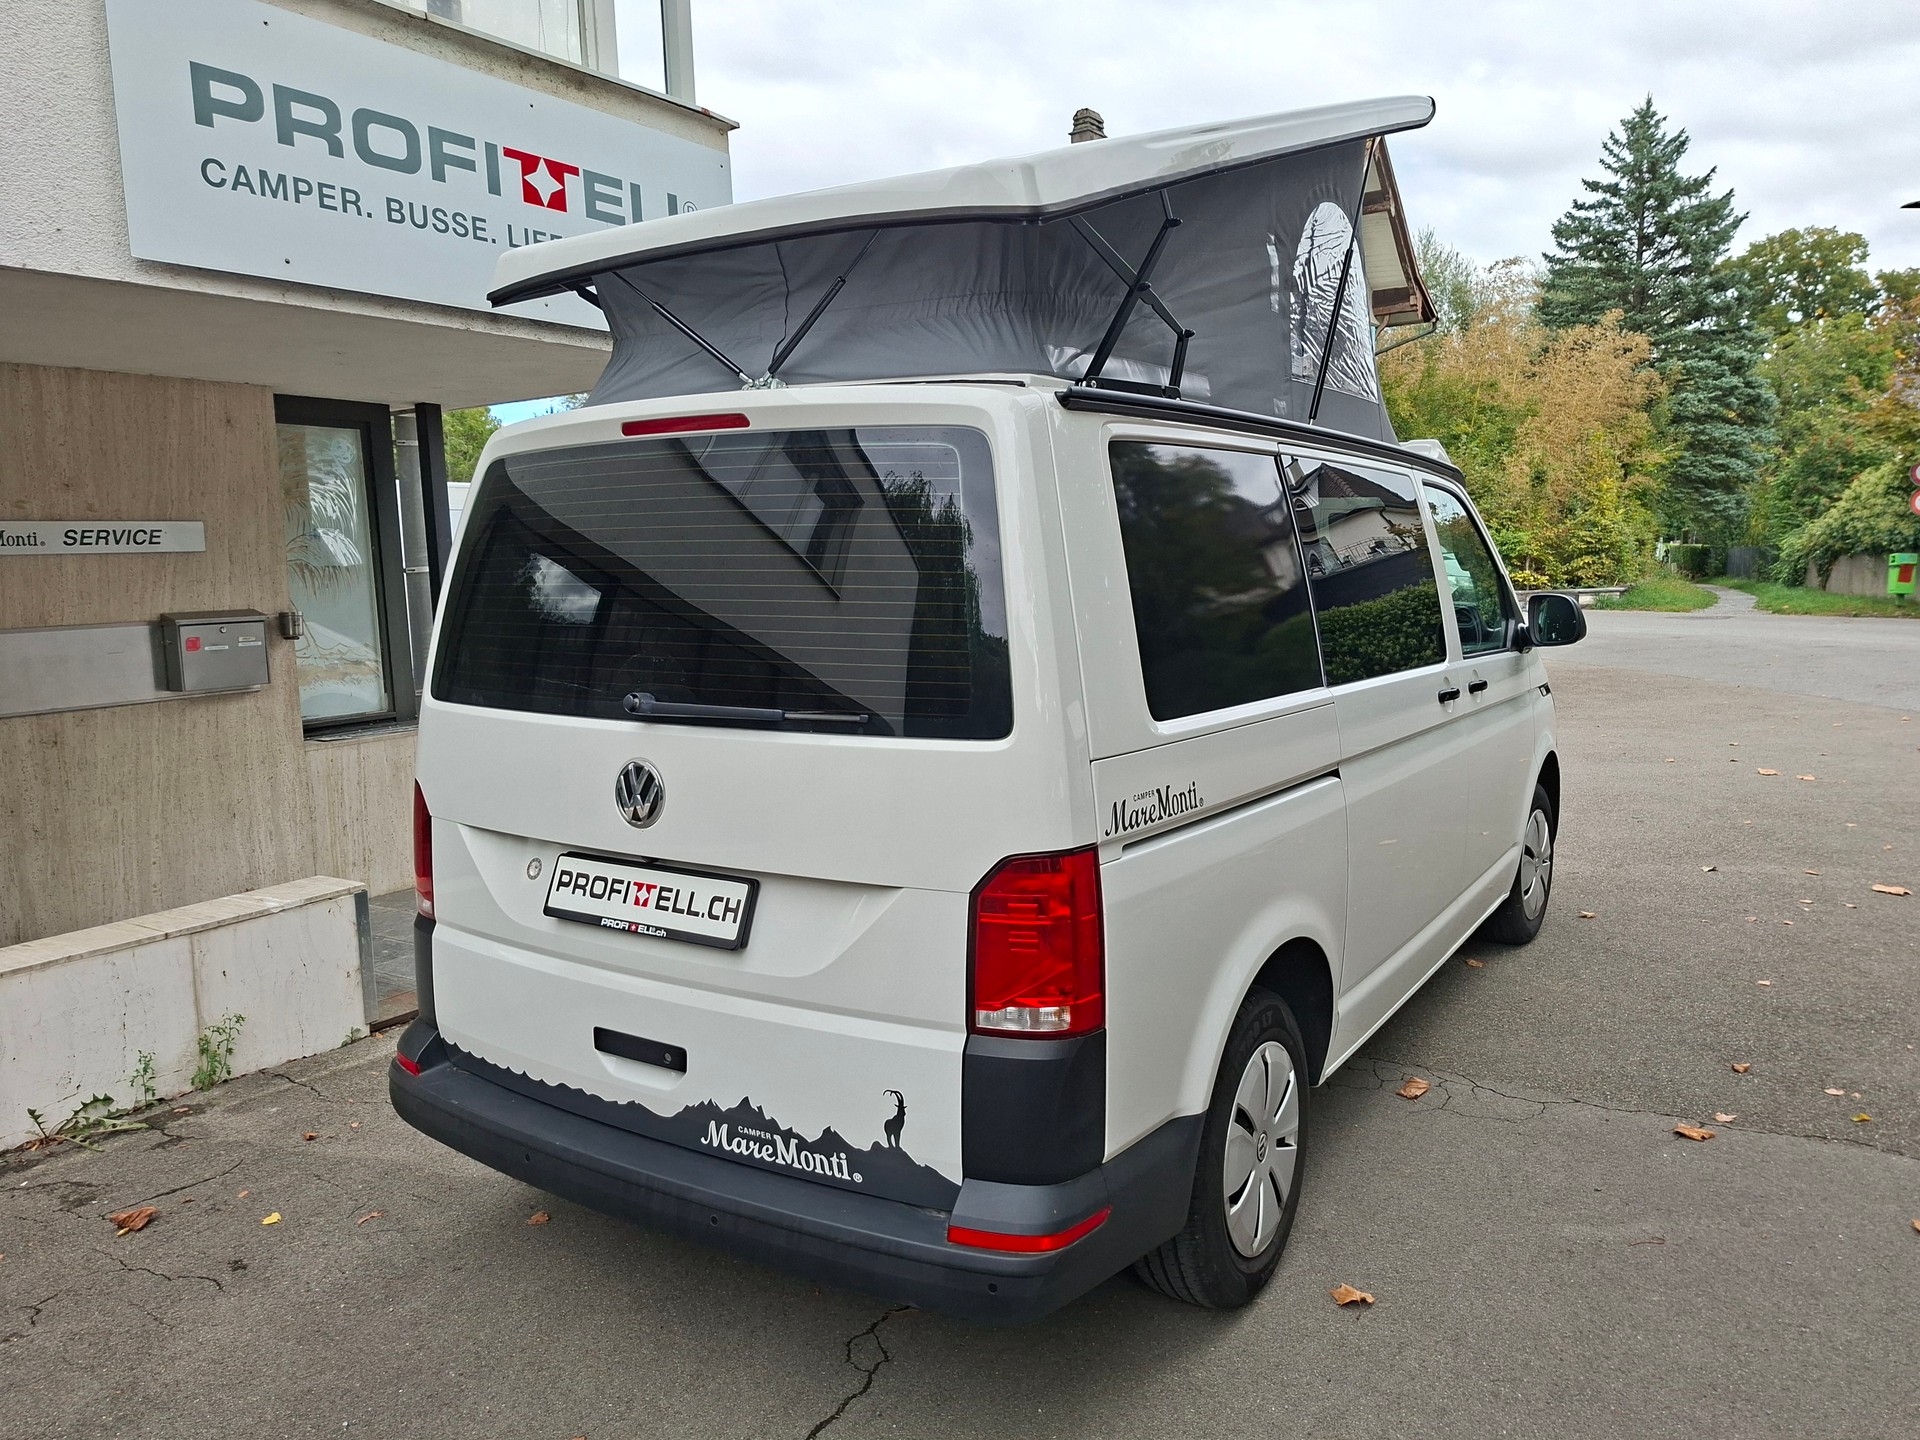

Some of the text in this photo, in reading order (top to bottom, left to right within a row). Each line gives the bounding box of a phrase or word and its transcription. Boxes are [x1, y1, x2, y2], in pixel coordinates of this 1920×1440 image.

[200, 157, 373, 219] CAMPER.
[386, 196, 497, 244] BUSSE.
[62, 528, 163, 546] SERVICE
[1133, 789, 1156, 802] CAMPER
[737, 1125, 772, 1141] CAMPER
